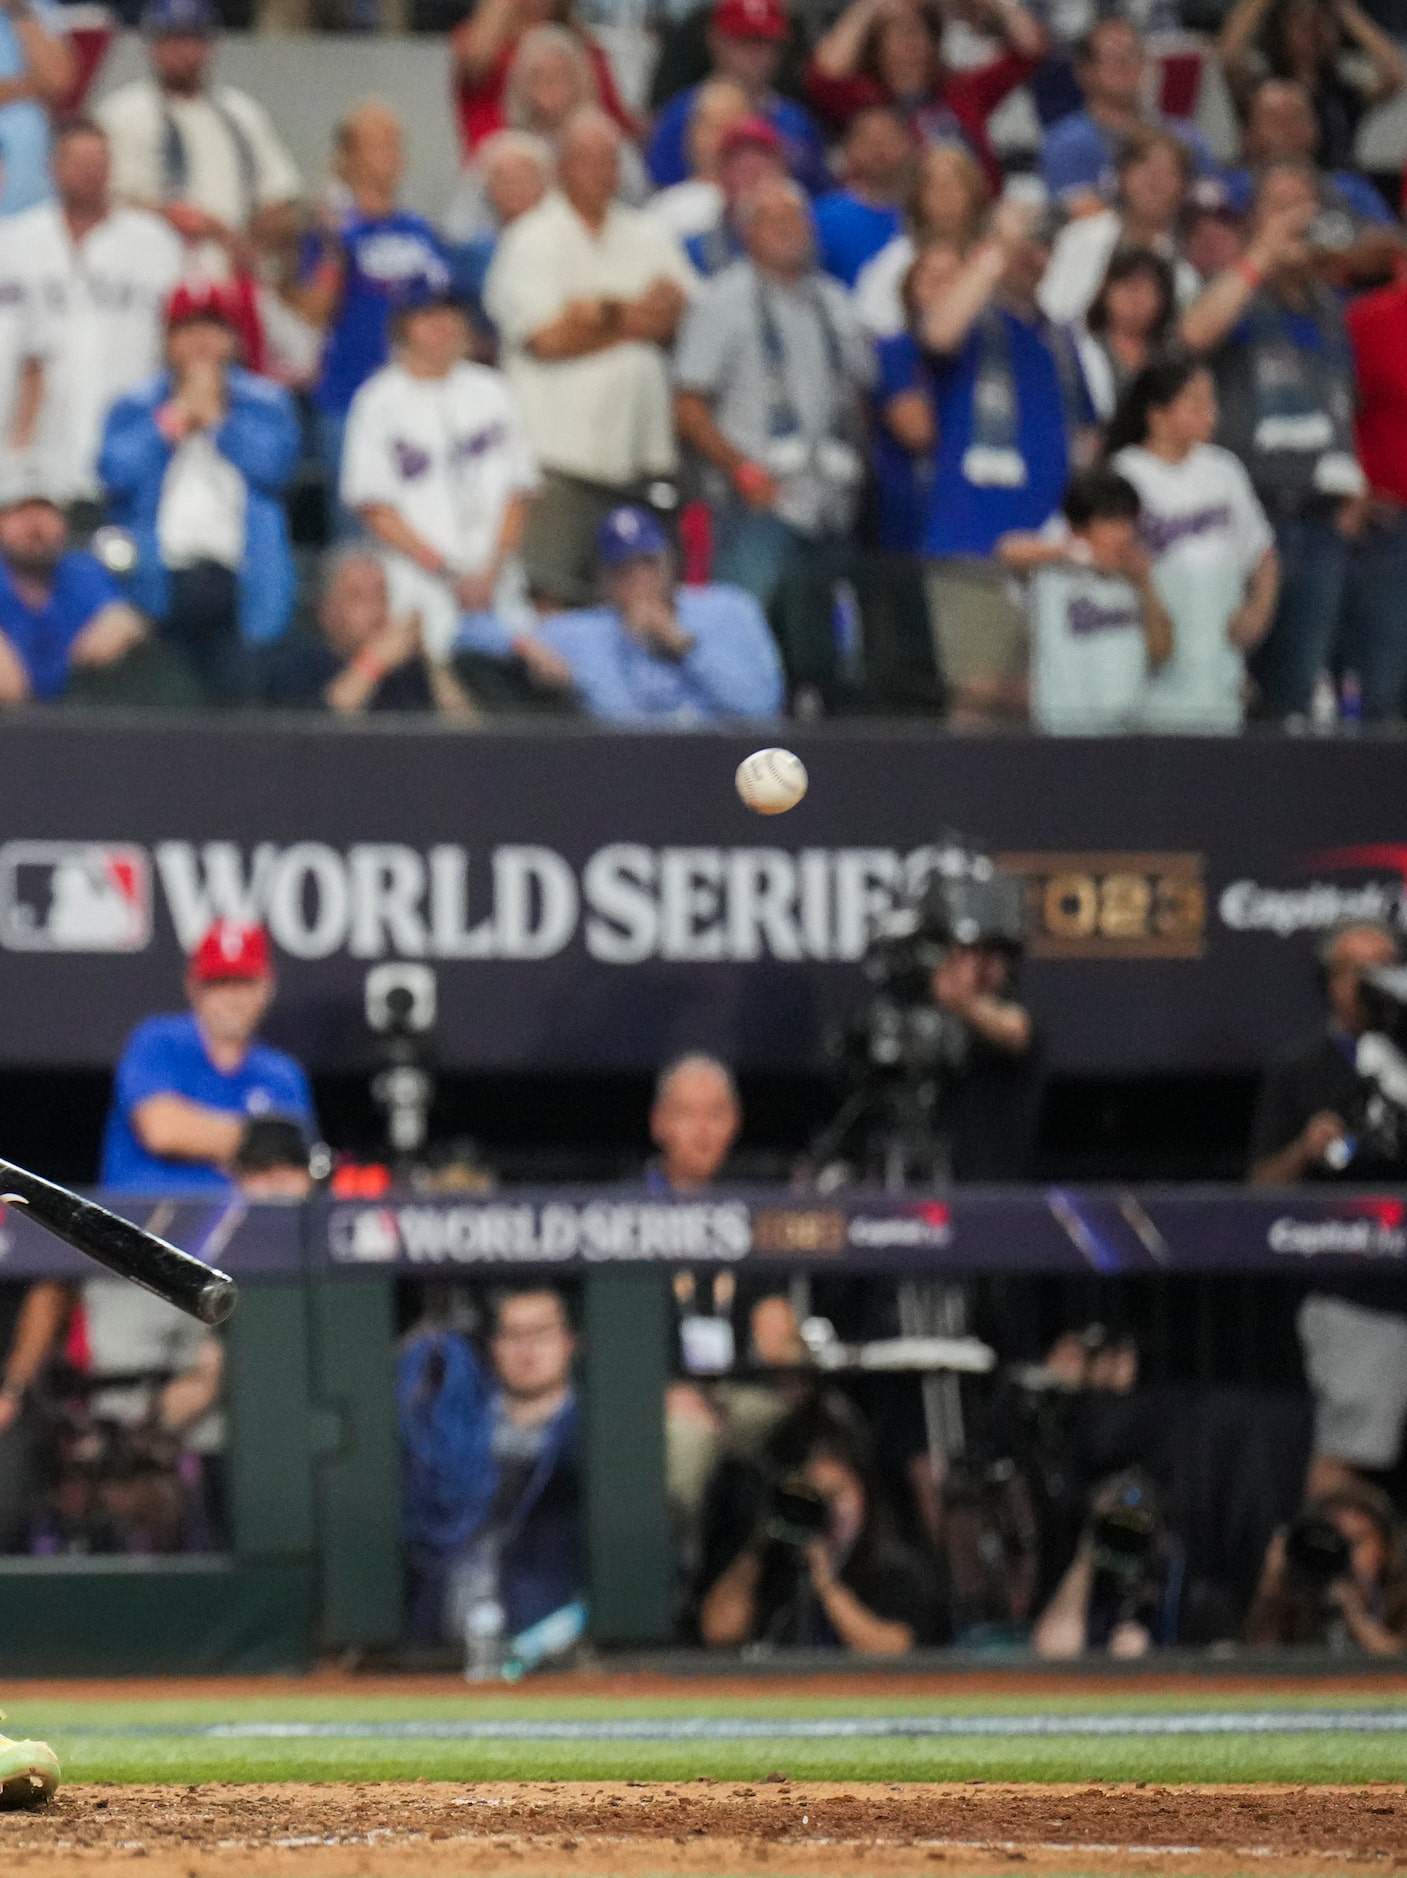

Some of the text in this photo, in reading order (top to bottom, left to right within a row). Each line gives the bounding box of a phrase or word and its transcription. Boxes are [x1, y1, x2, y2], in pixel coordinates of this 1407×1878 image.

[155, 840, 579, 960] WORLD
[398, 1203, 578, 1263] WORLD
[582, 1201, 752, 1262] SERIES
